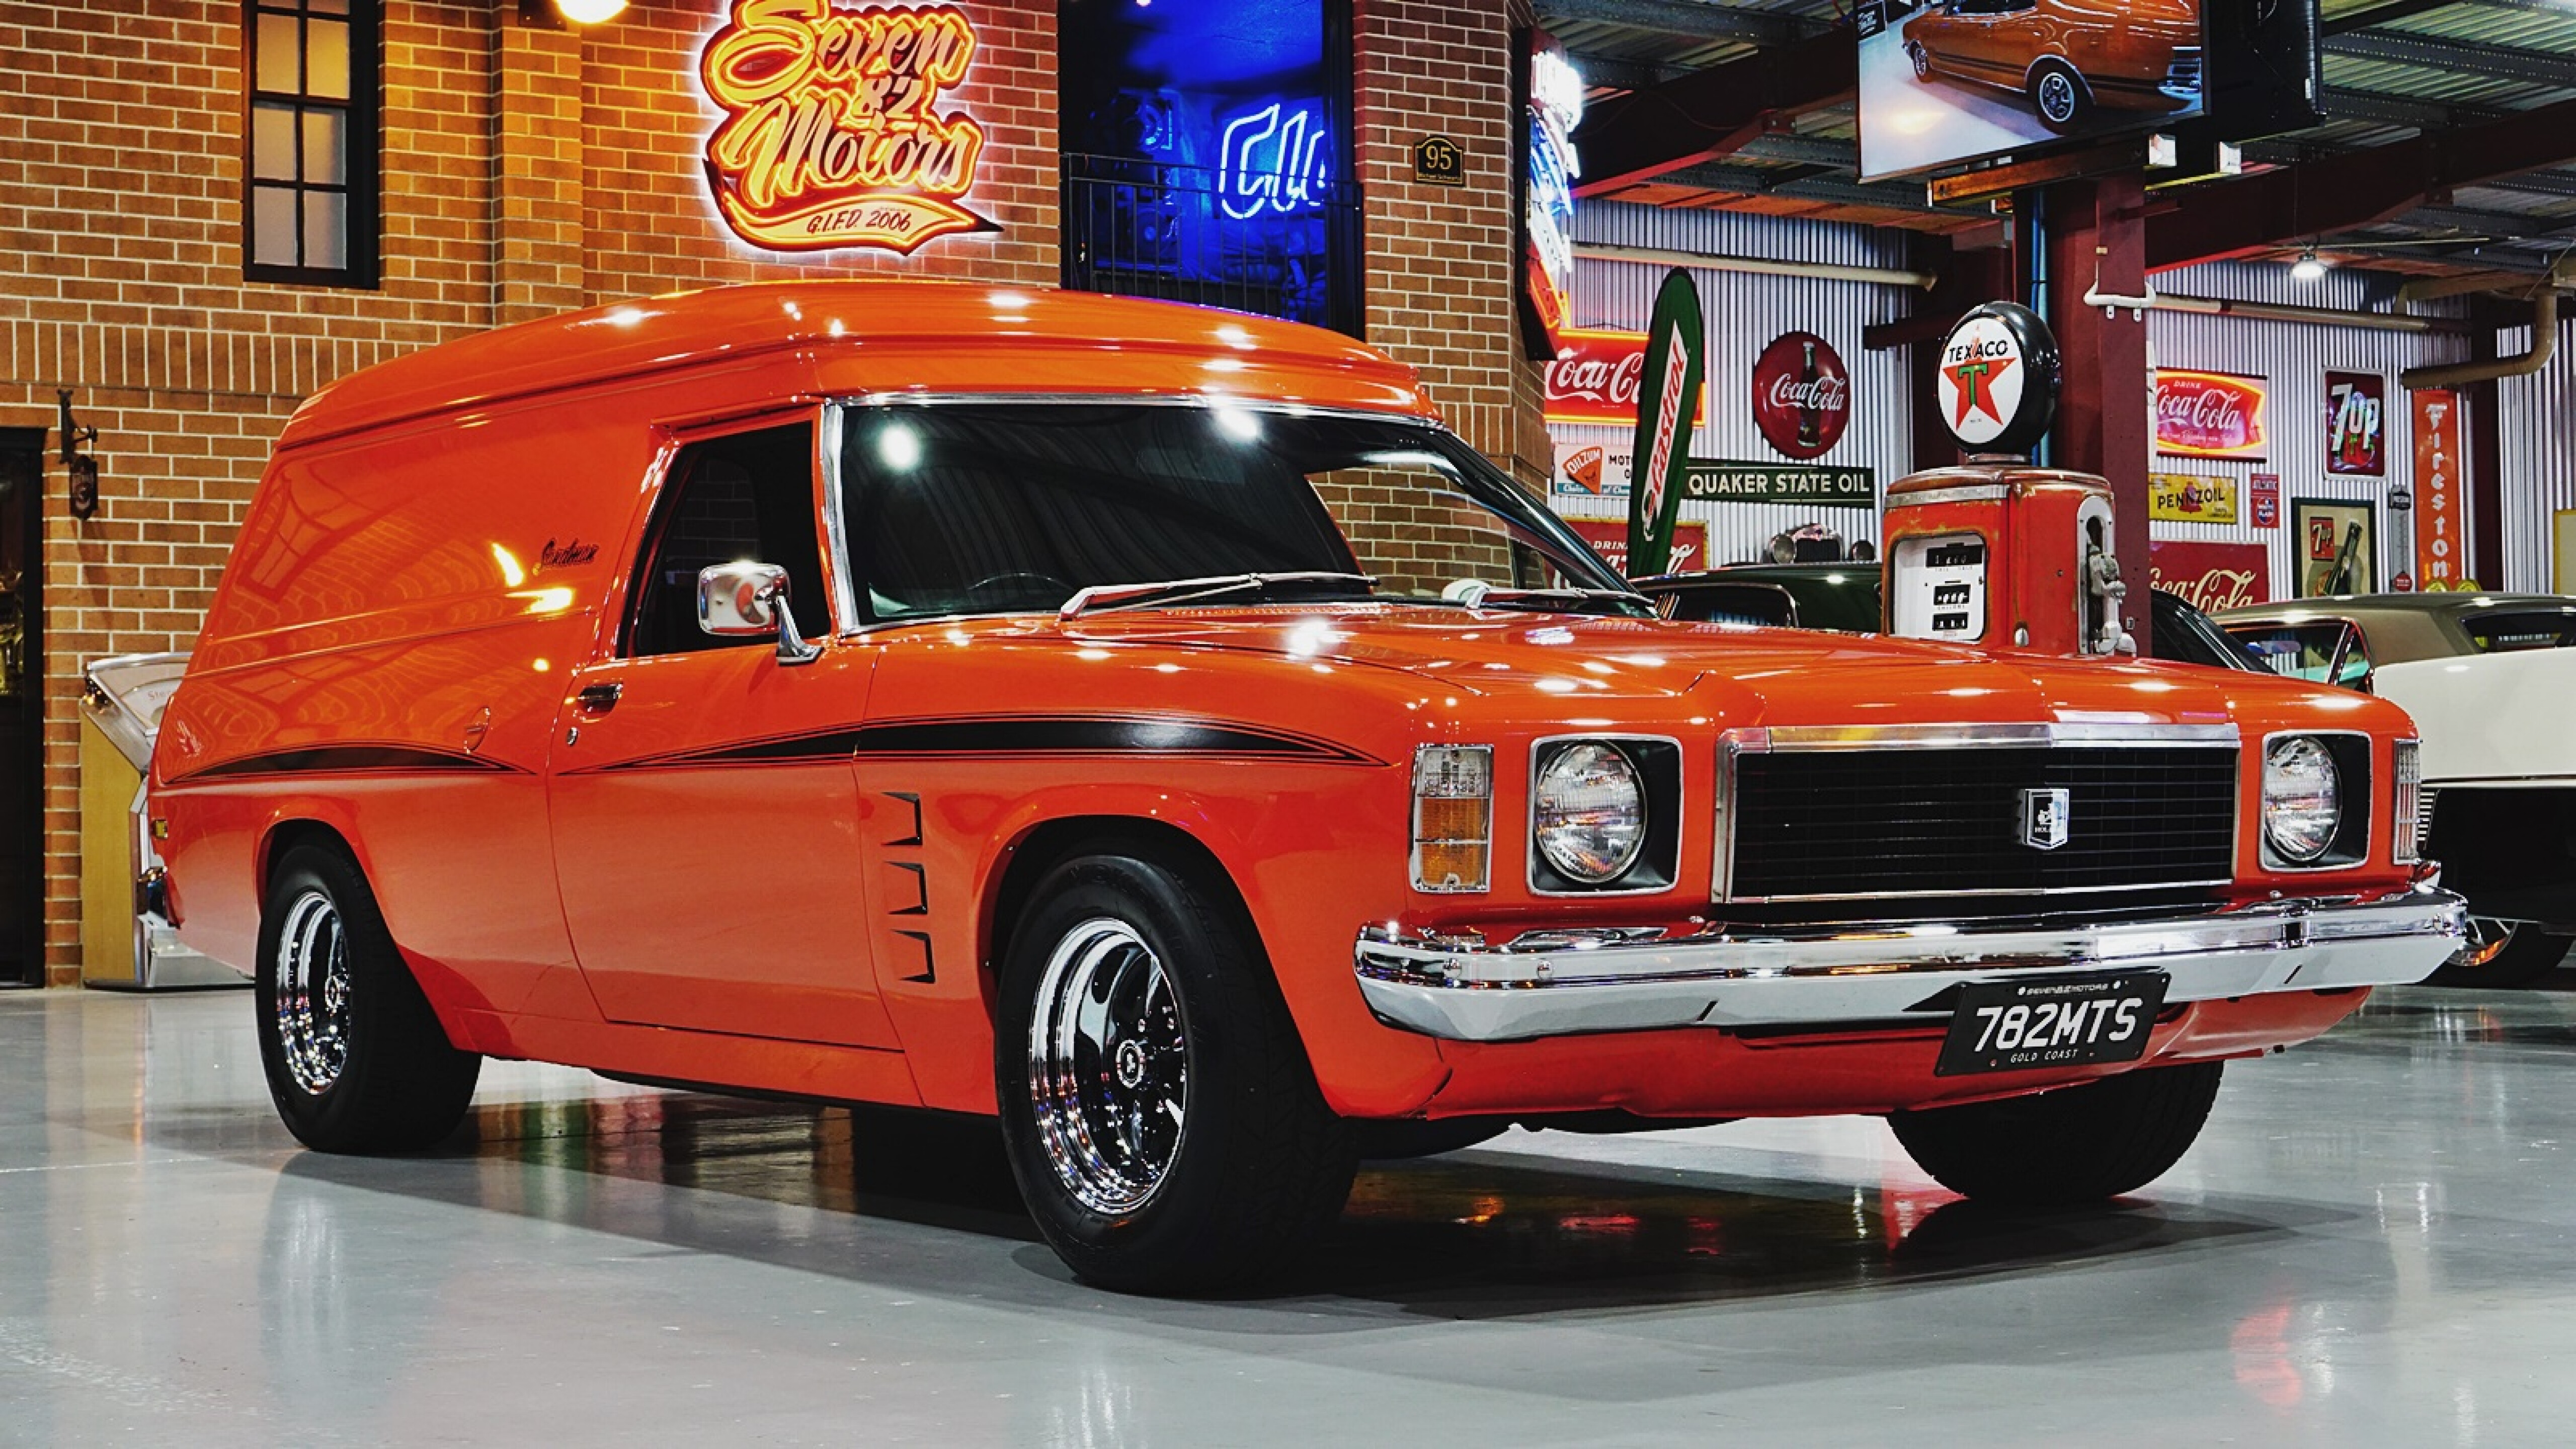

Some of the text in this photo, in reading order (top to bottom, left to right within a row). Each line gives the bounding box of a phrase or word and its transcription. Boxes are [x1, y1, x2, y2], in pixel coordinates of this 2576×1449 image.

[710, 0, 964, 103] Seven
[720, 96, 968, 207] Motors
[1426, 145, 1453, 170] 95
[865, 209, 912, 232] 2006
[1949, 339, 2008, 363] TEXACO
[1546, 352, 1645, 405] Coca-C
[1770, 373, 1846, 412] Coca-Cola
[1957, 363, 1989, 407] T
[1688, 473, 1870, 496] QUAKER STATE OIL
[2157, 487, 2225, 510] PENNZOIL
[2425, 404, 2449, 579] Fireston
[1593, 540, 1628, 549] DRIN
[1974, 997, 2143, 1053] 782MTS
[2010, 1048, 2079, 1063] GOLD COAST
